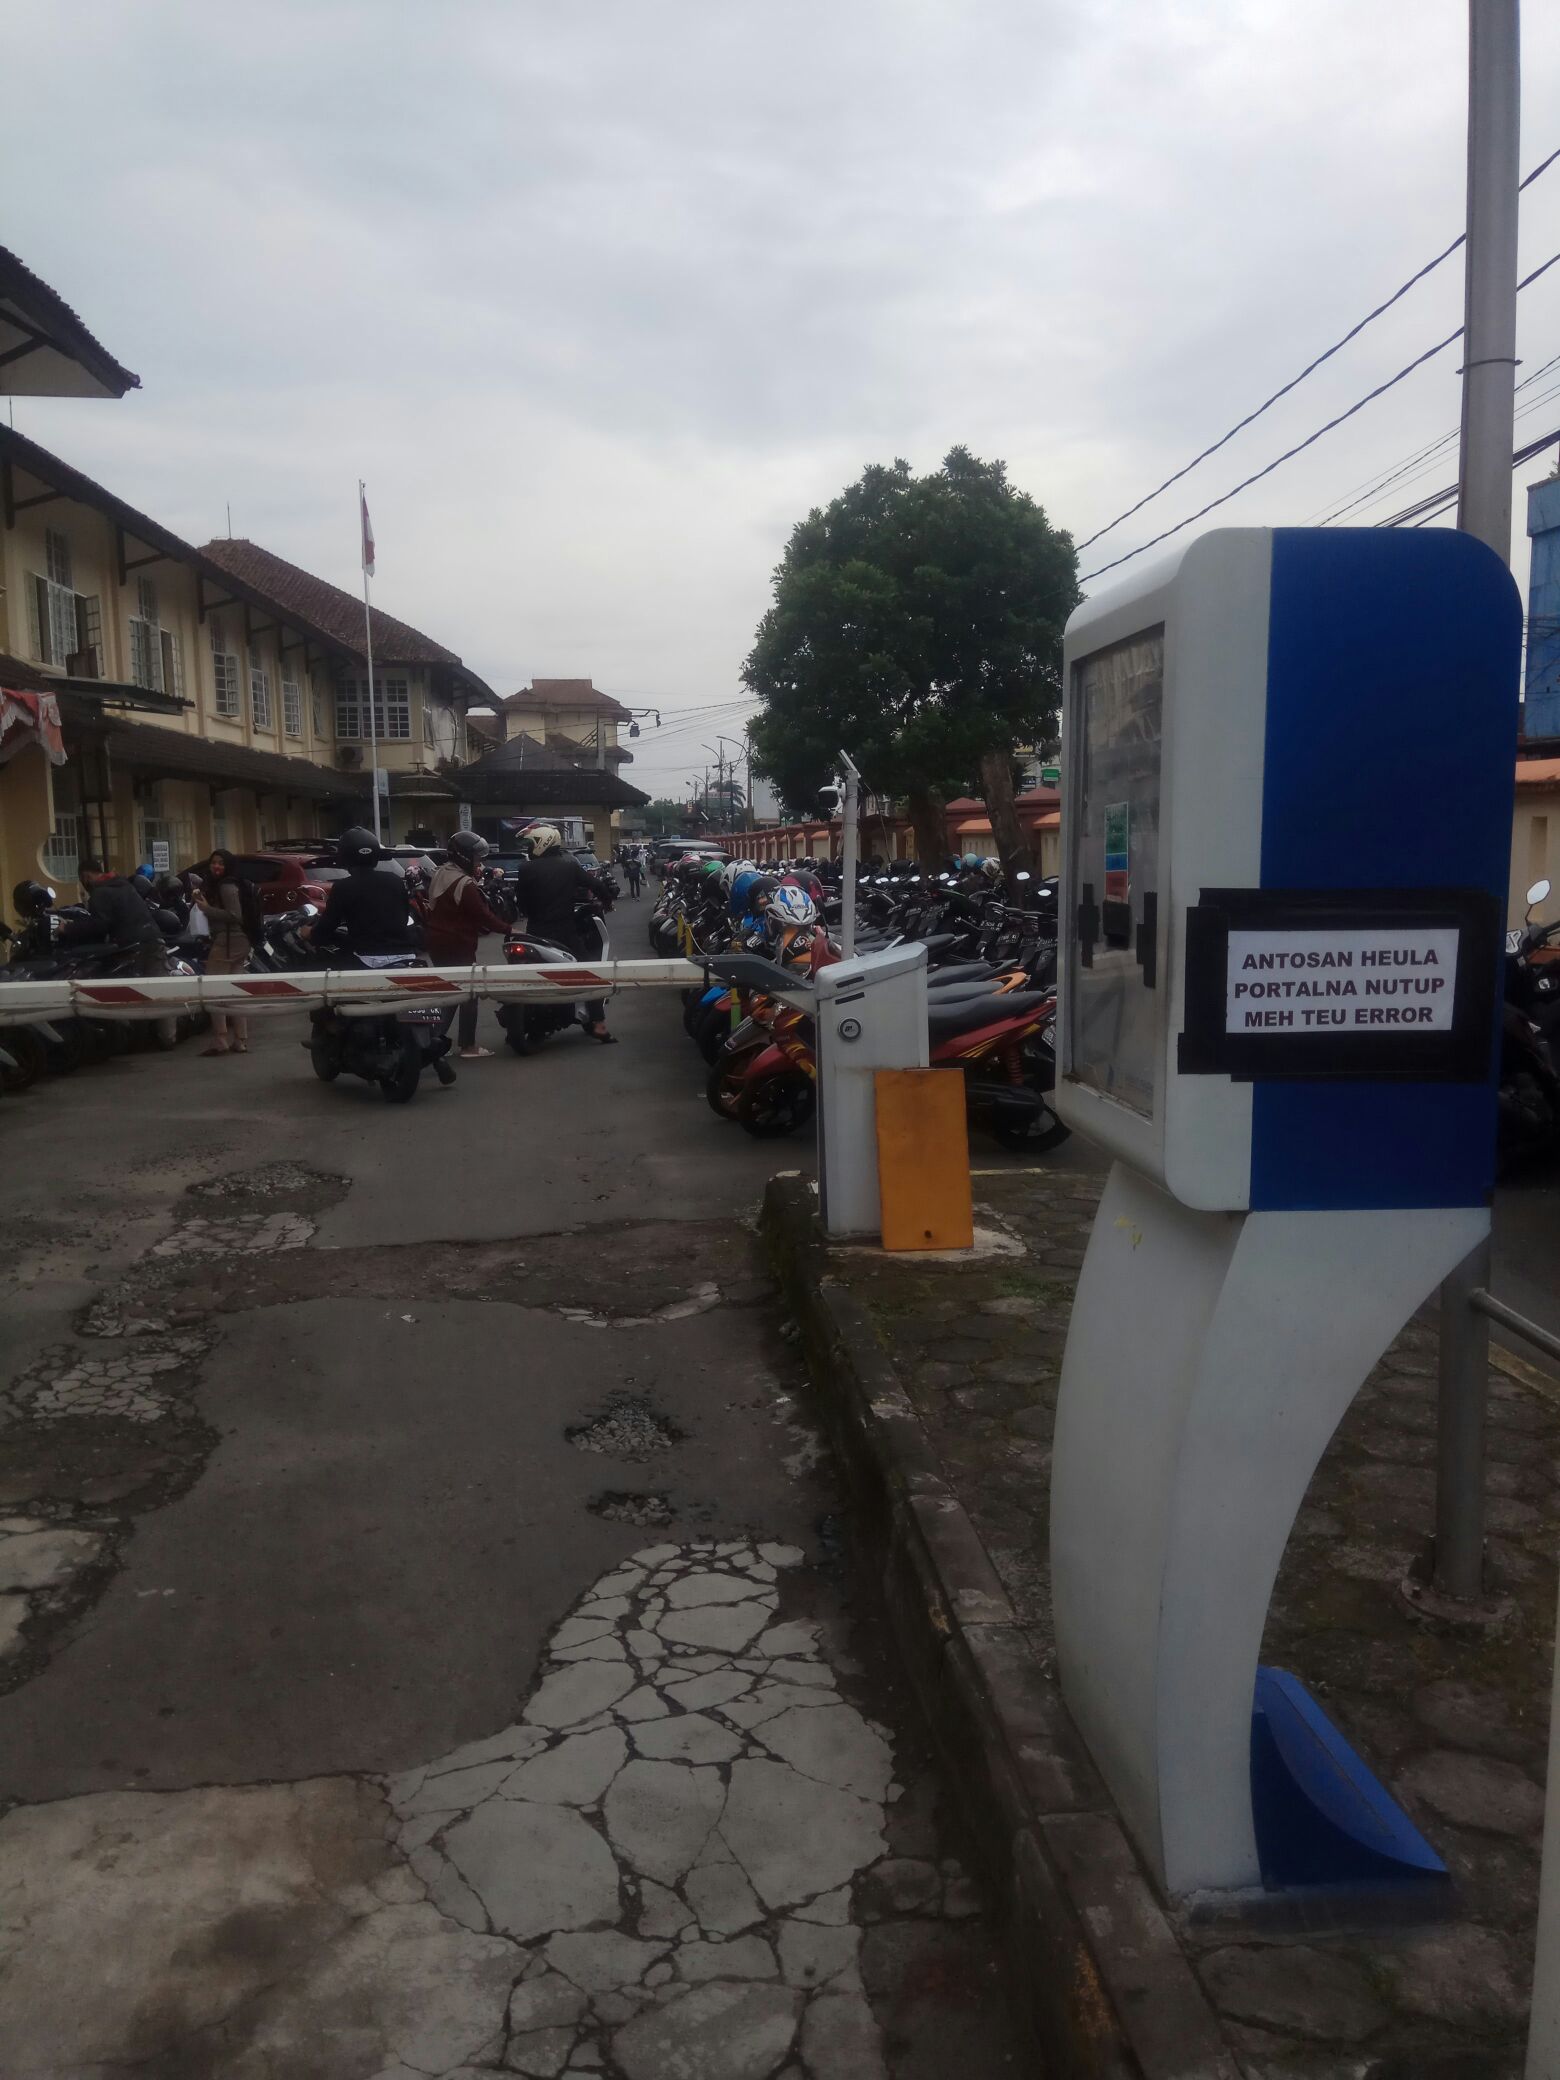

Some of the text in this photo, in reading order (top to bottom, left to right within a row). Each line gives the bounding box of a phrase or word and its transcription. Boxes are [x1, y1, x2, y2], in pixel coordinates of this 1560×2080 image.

[1241, 948, 1440, 970] ANTOSAN HEULA
[1234, 977, 1445, 999] PORTALNA NUTUP
[1244, 1006, 1434, 1028] MEH TEU ERROR
